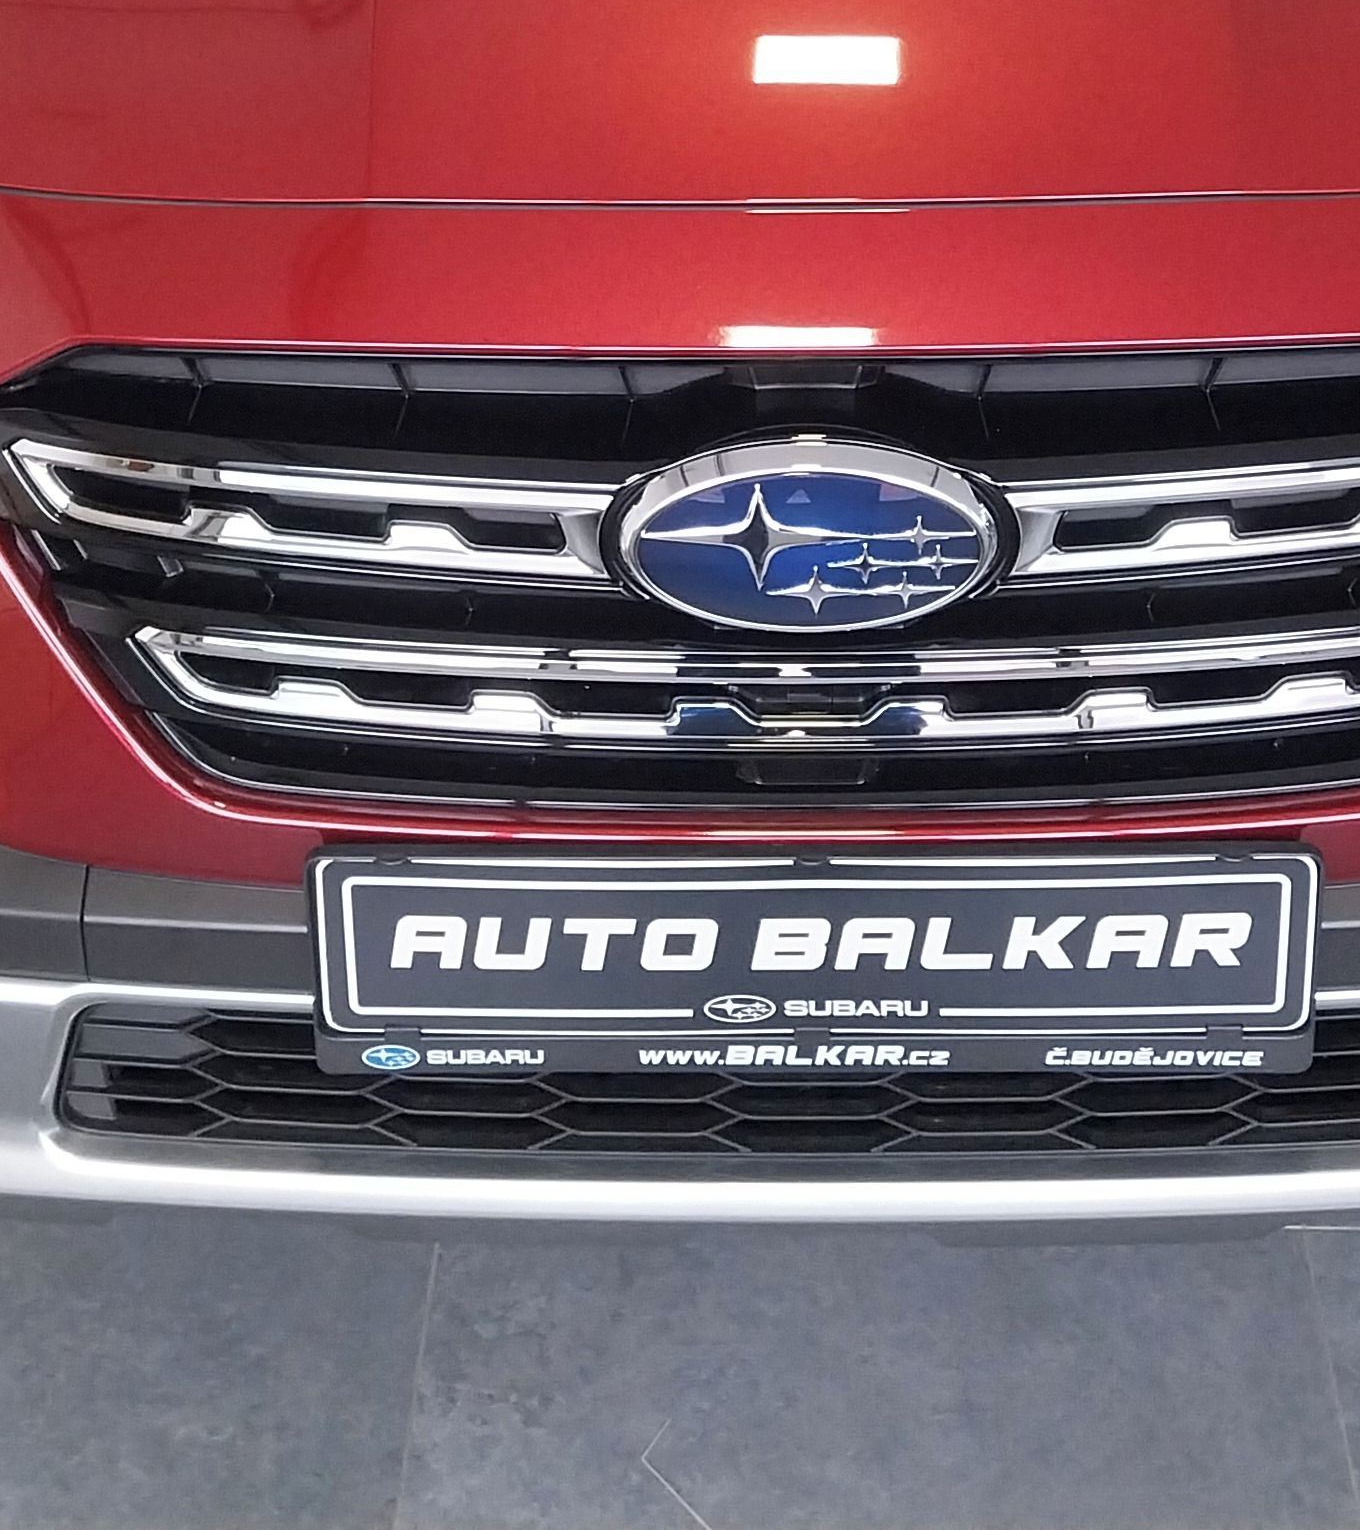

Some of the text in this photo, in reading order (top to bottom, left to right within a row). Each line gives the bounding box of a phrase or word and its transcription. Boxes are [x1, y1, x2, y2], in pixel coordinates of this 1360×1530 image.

[390, 912, 1253, 971] AUTO BALKAR
[783, 999, 929, 1017] SUBARU
[426, 1049, 545, 1065] SUBARU
